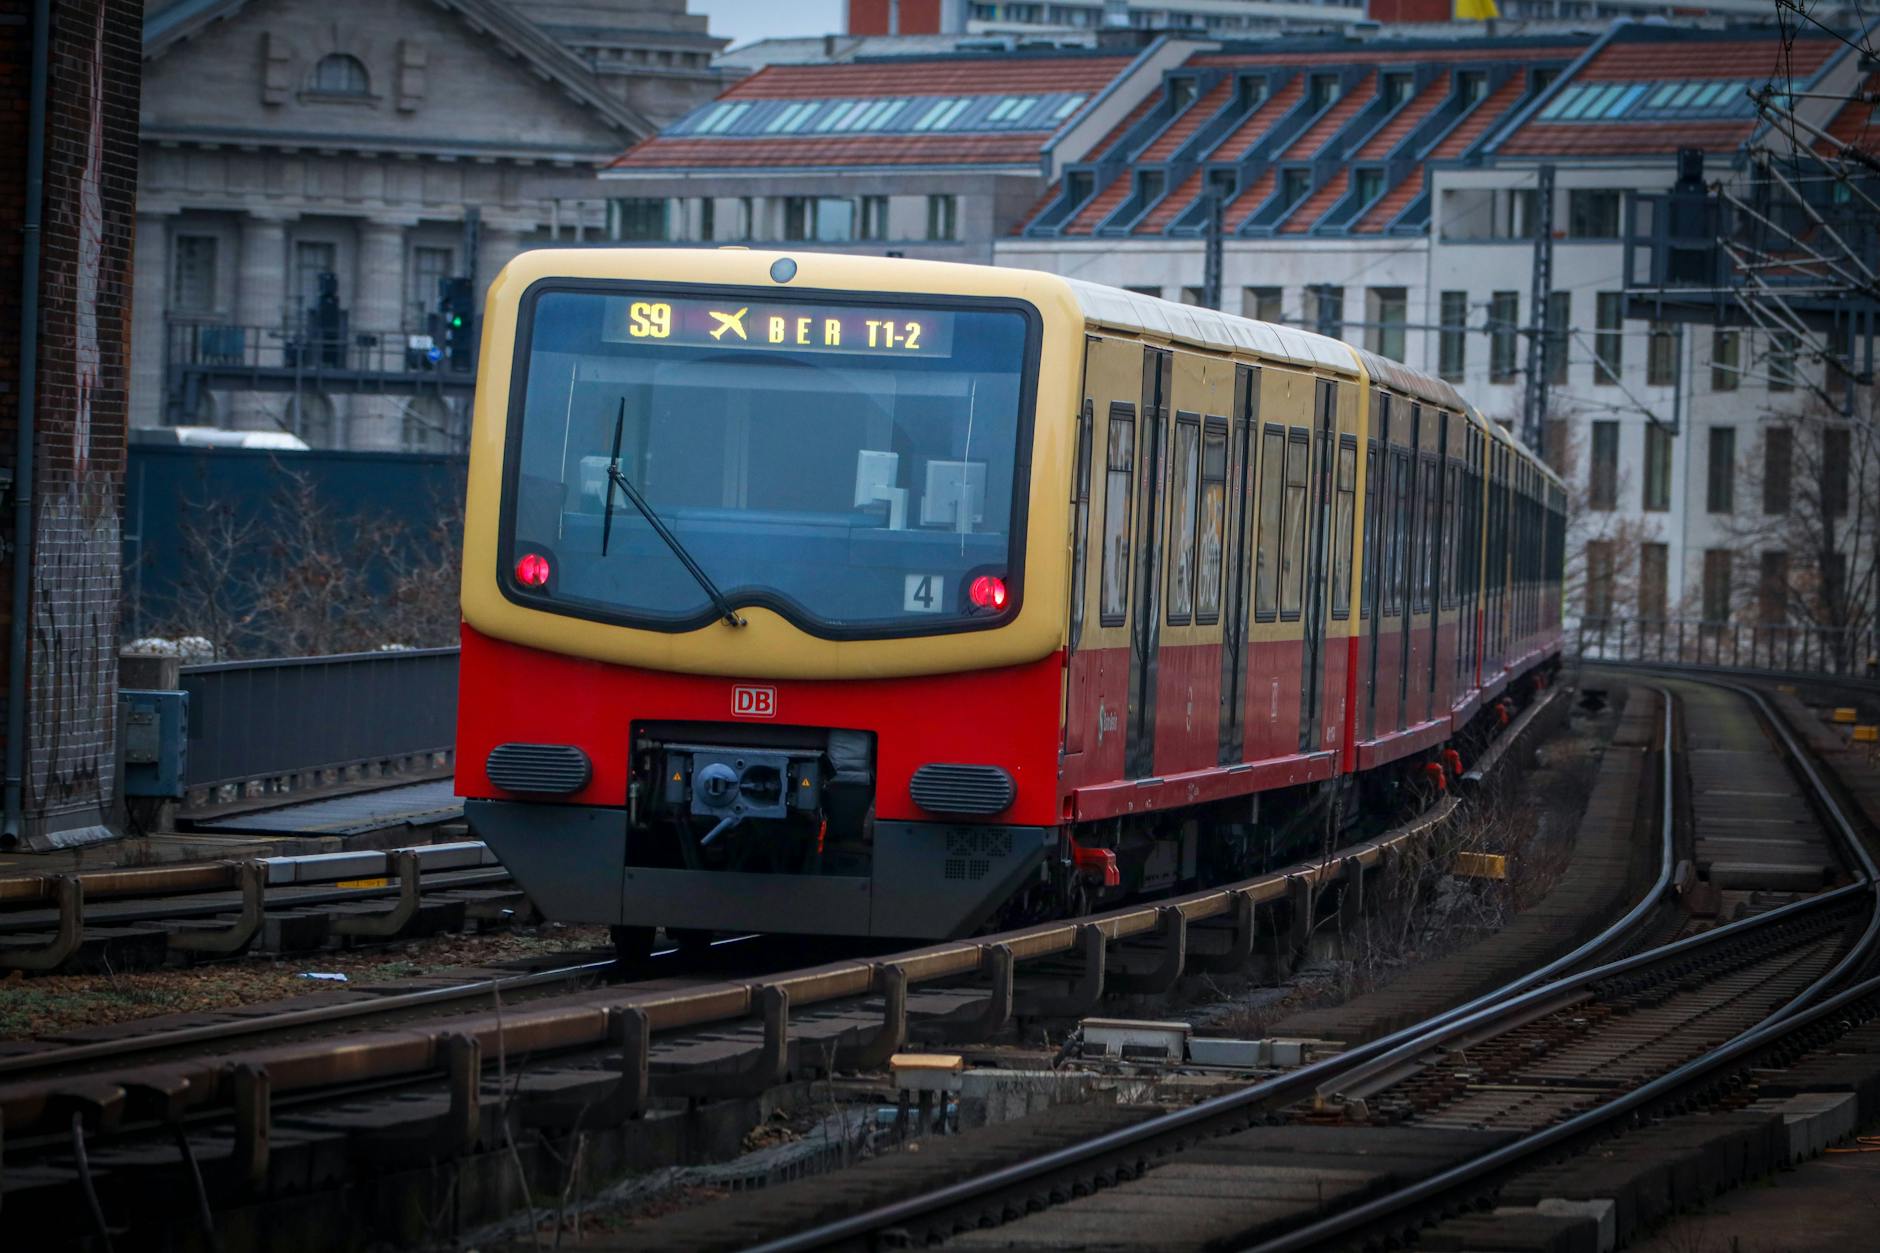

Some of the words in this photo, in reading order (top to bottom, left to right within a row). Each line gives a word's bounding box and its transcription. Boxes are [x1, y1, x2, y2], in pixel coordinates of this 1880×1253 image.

[629, 302, 672, 338] S9
[865, 320, 921, 349] T1-2
[913, 575, 934, 609] 4
[737, 690, 771, 712] DB
